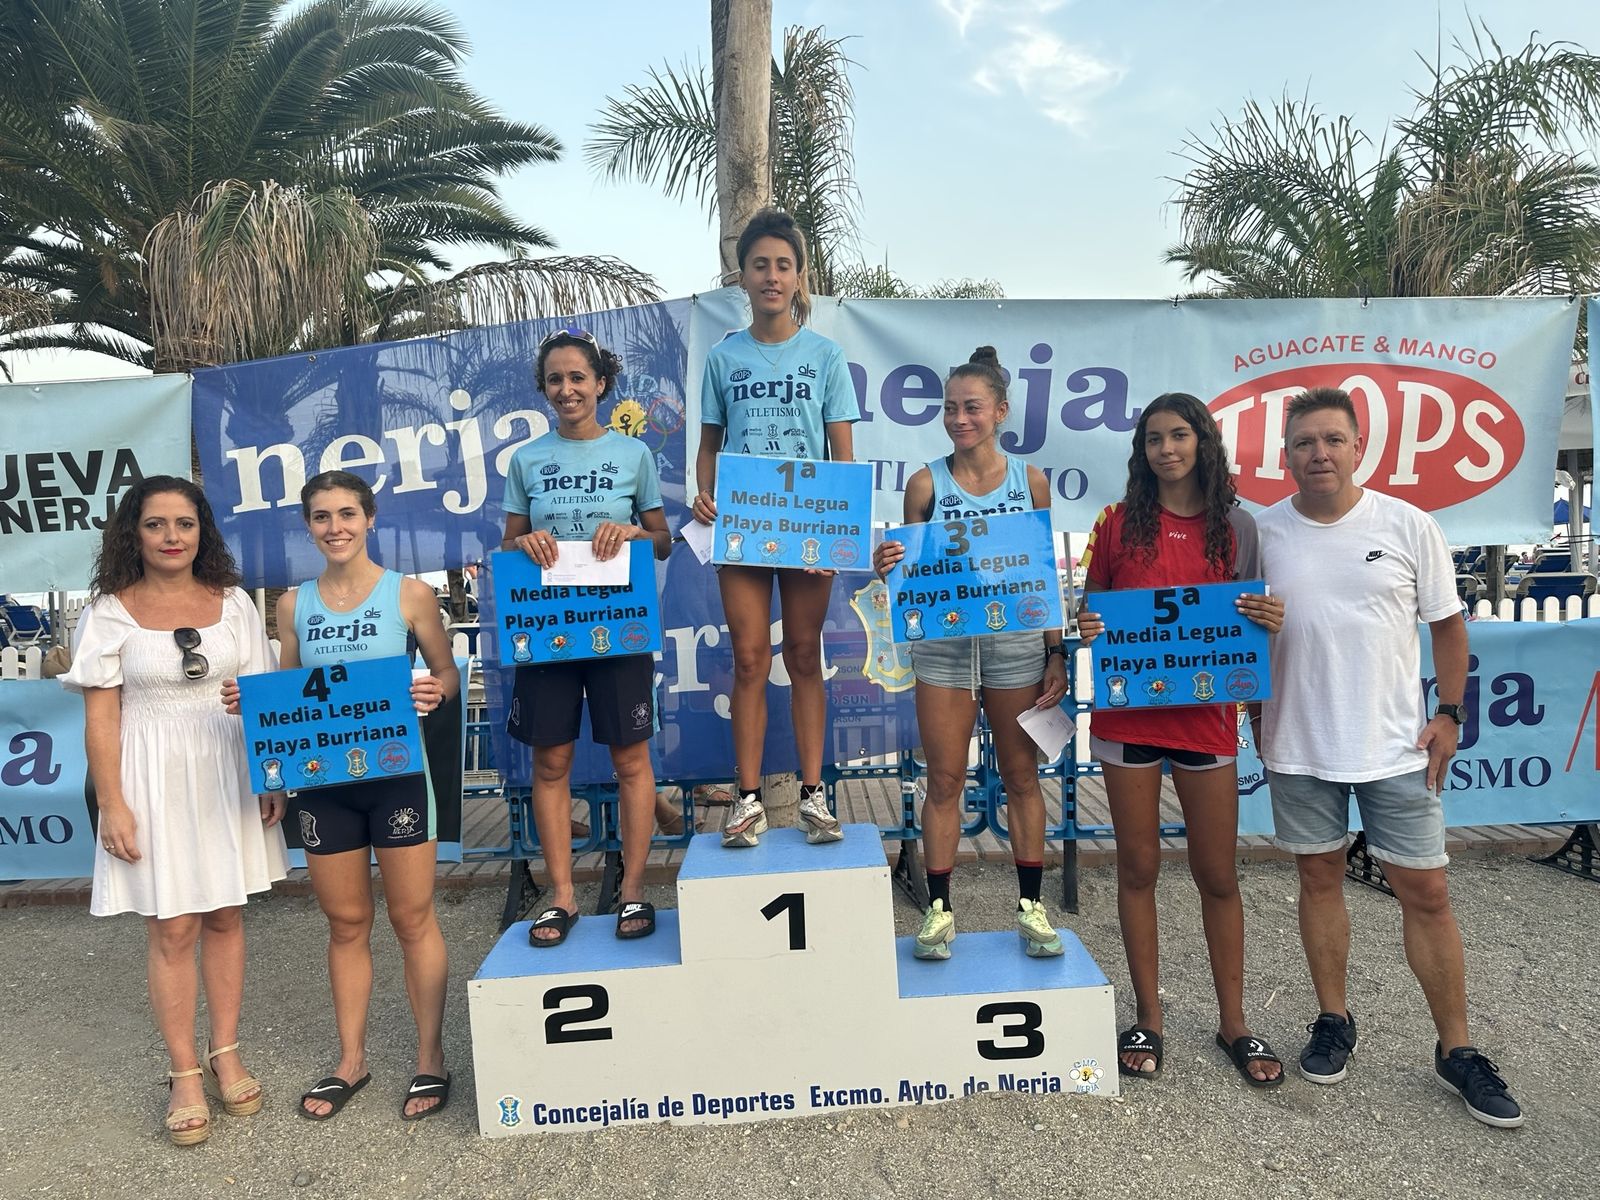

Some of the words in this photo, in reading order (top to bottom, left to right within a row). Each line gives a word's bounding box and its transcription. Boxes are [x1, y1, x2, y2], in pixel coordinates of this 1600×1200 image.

[1233, 335, 1365, 372] AGUACATE
[1373, 335, 1390, 353] &
[1399, 338, 1497, 370] MANGO
[731, 369, 752, 382] TROPS
[733, 374, 812, 404] nerja
[846, 342, 1142, 455] eja
[744, 407, 801, 418] ATLETISMO
[226, 388, 550, 514] nerja
[540, 464, 560, 475] TROPS
[542, 470, 613, 494] nerja
[550, 495, 605, 505] ATLETISMO
[731, 490, 787, 508] Media
[794, 495, 849, 514] Legua
[0, 495, 118, 535] NERJ
[722, 514, 773, 534] Playa
[779, 519, 860, 536] Burriana
[1168, 531, 1188, 540] vive
[902, 559, 962, 579] Media
[969, 554, 1030, 573] Legua
[511, 585, 570, 603] Media
[576, 581, 633, 599] Legua
[896, 586, 952, 607] Playa
[957, 578, 1047, 601] Burriana
[307, 619, 378, 642] nerja
[505, 613, 558, 631] Playa
[564, 605, 648, 624] Burriana
[1106, 627, 1170, 645] Media
[1178, 624, 1242, 643] Legua
[314, 643, 368, 655] ATLETISMO
[1101, 656, 1157, 675] Playa
[1164, 651, 1258, 669] Burriana
[259, 706, 322, 728] Media
[328, 699, 391, 719] Legua
[1421, 654, 1545, 750] rja
[255, 738, 311, 756] Playa
[317, 724, 407, 747] Burriana
[761, 892, 806, 950] 1
[543, 983, 613, 1044] 2
[976, 1001, 1045, 1060] 3
[533, 1097, 649, 1126] Concejalía
[658, 1095, 684, 1117] de
[692, 1091, 795, 1118] Deportes
[810, 1085, 889, 1108] Excmo.
[898, 1079, 954, 1105] Ayto.
[963, 1076, 990, 1097] de
